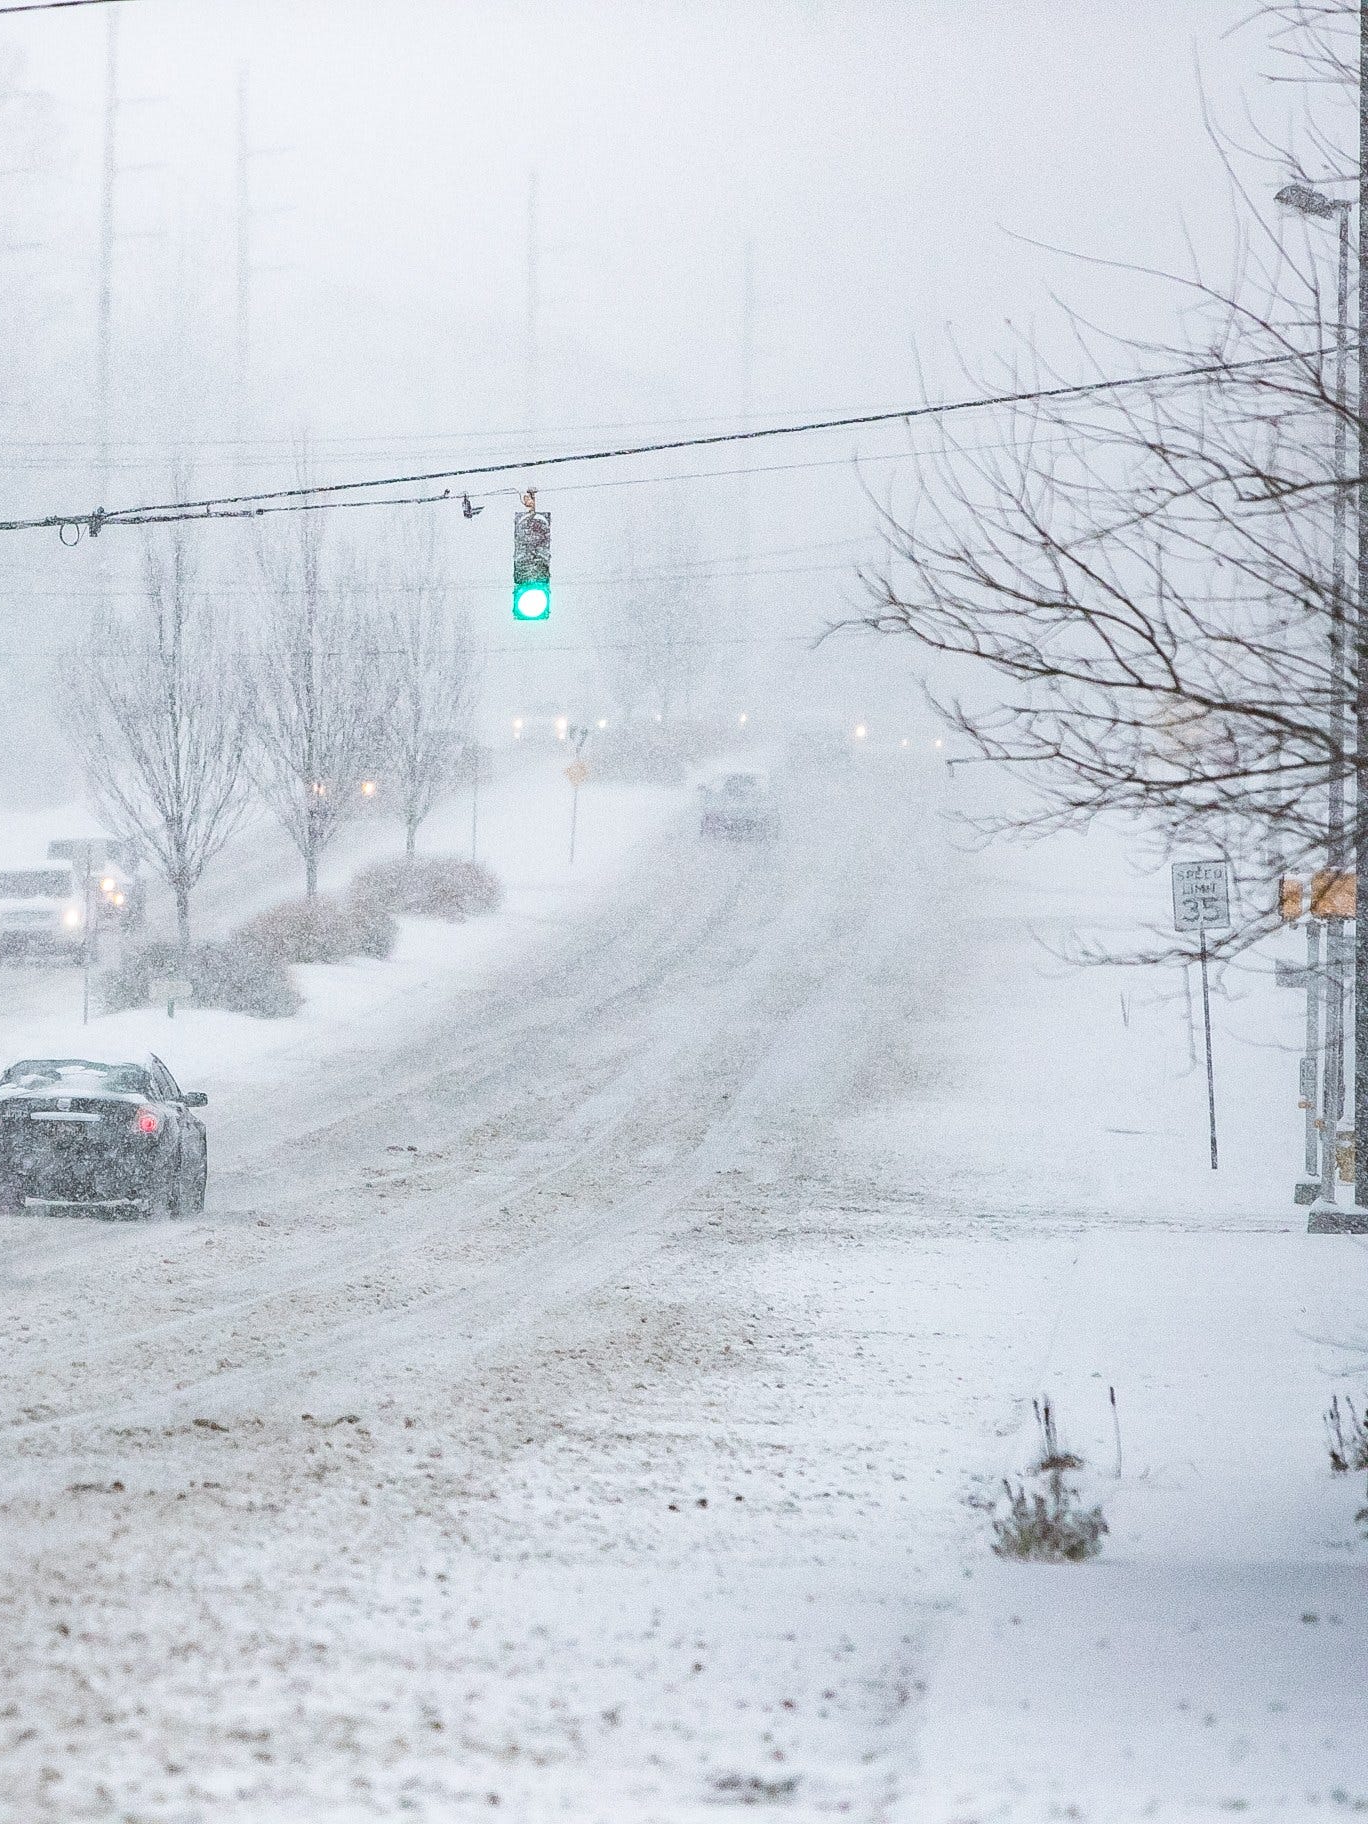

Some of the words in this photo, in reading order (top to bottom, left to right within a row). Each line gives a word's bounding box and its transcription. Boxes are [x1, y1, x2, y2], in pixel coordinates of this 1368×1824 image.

[1177, 869, 1222, 880] SPEED
[1182, 882, 1218, 895] LIMIT
[1182, 898, 1220, 922] 35
